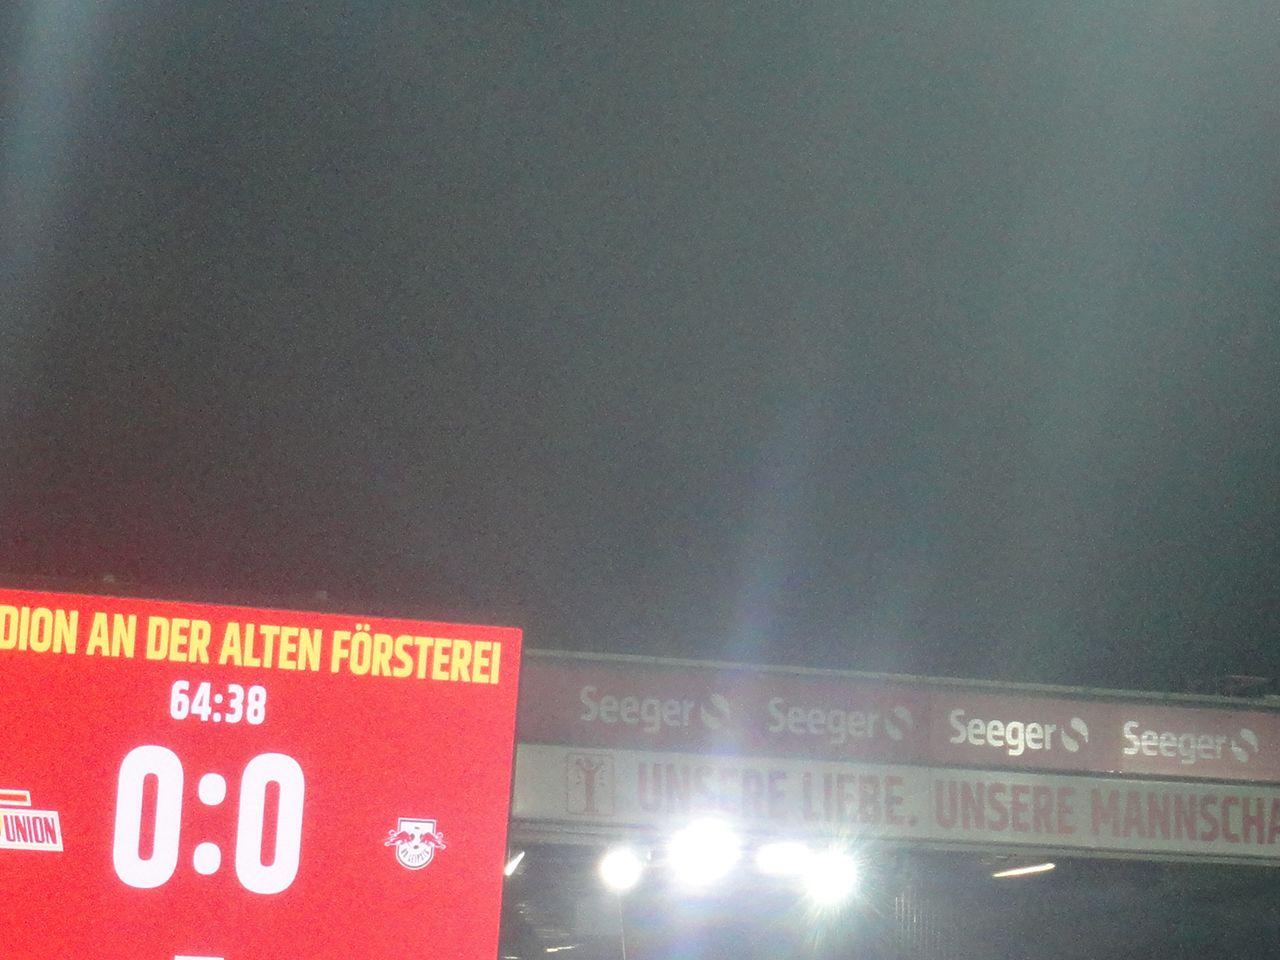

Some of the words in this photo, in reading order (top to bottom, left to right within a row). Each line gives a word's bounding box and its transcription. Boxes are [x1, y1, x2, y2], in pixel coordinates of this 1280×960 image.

[86, 612, 134, 658] AN
[146, 617, 210, 664] DER
[219, 624, 323, 673] ALTEN
[330, 624, 502, 684] FÖRSTEREI
[170, 680, 267, 725] 64:38
[580, 686, 695, 733] Seeger
[770, 697, 880, 744] Seeger
[949, 708, 1056, 756] Seeger
[1123, 720, 1226, 765] Seeger
[3, 814, 57, 845] UNION
[934, 779, 1077, 835] UNSERE
